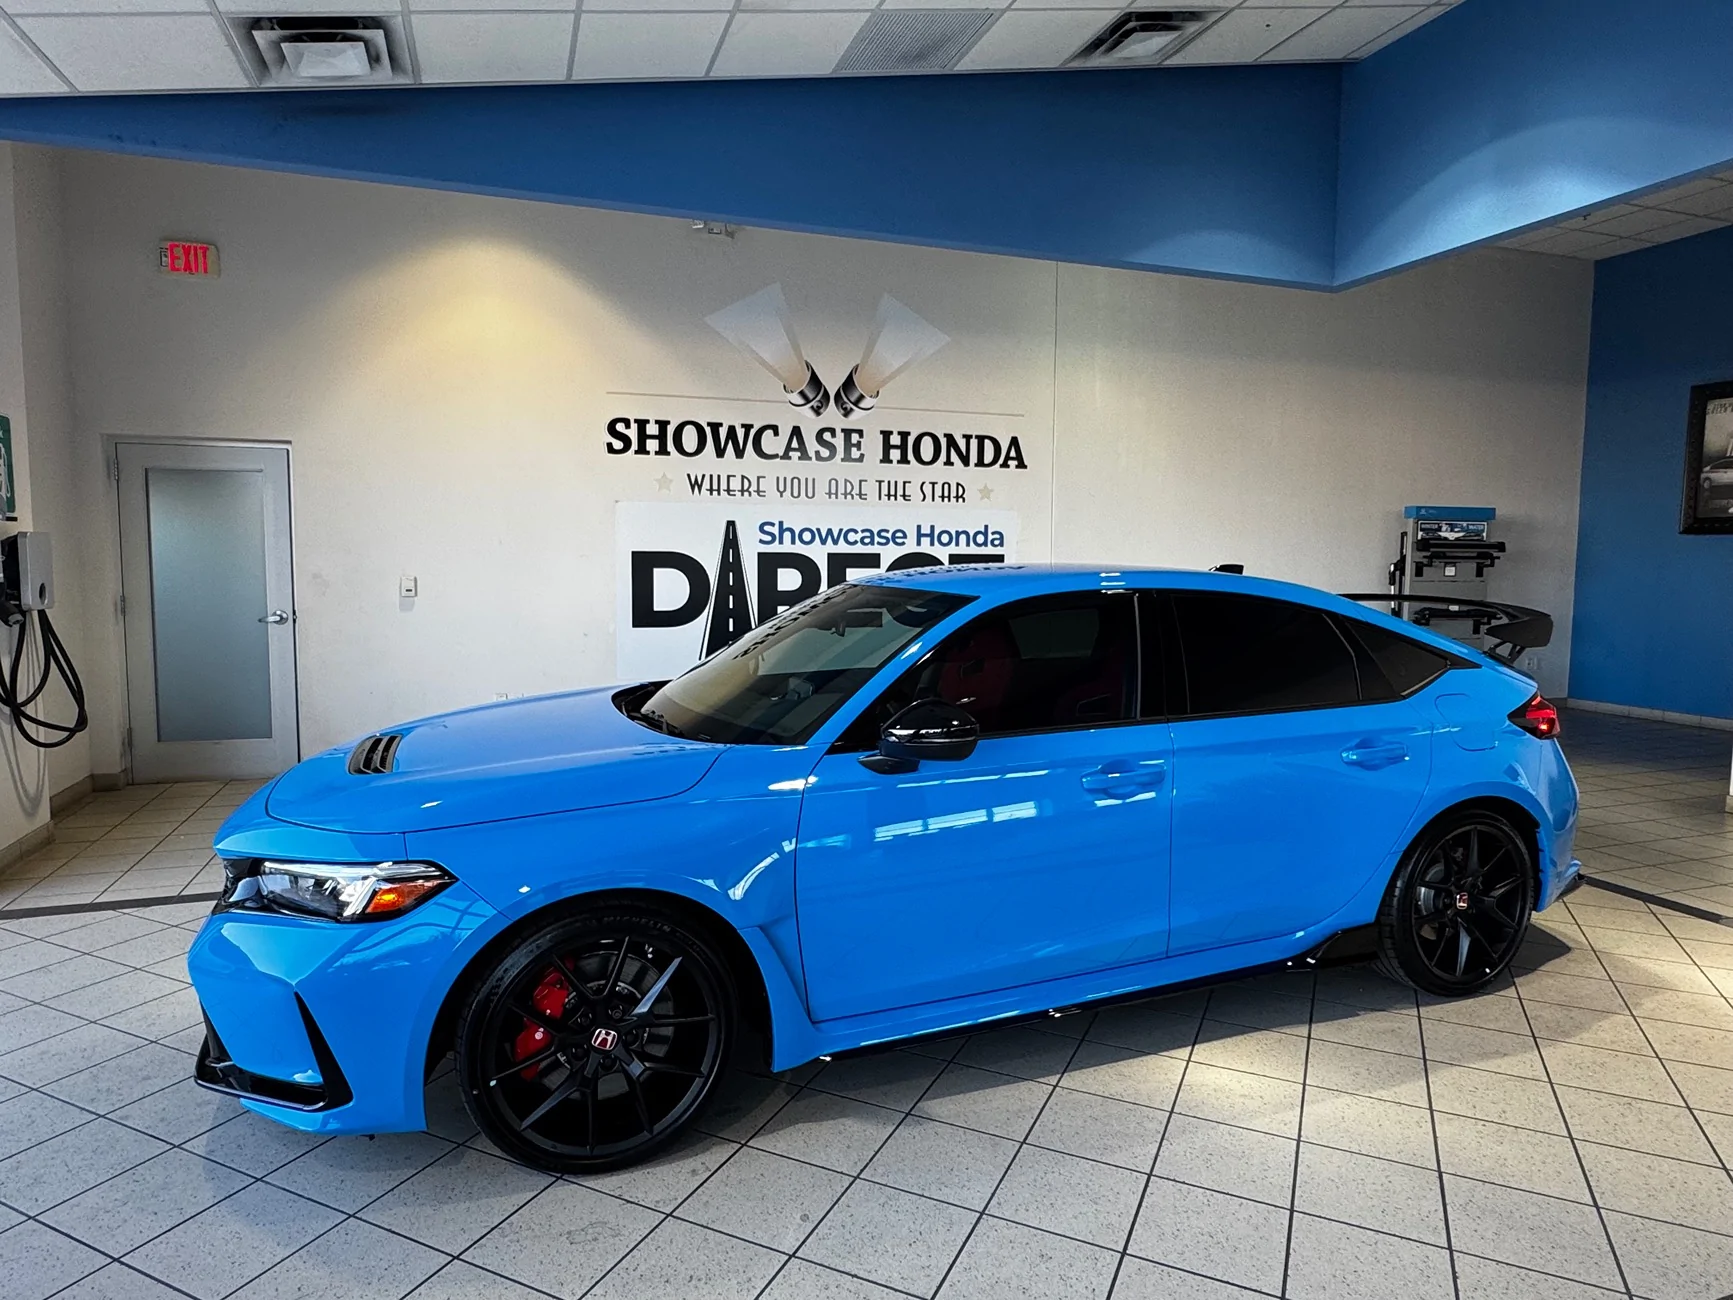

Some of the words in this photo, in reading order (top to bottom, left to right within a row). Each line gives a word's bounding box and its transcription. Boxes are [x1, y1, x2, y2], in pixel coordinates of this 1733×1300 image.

[168, 242, 209, 274] EXIT
[605, 416, 866, 463] SHOWCASE
[879, 429, 1028, 470] HONDA
[686, 472, 767, 498] WHERE
[775, 475, 817, 500] YOU
[824, 477, 868, 501] ARE
[874, 479, 912, 502] THE
[919, 480, 967, 504] STAR
[757, 520, 909, 547] Showcase
[916, 523, 1006, 548] Honda
